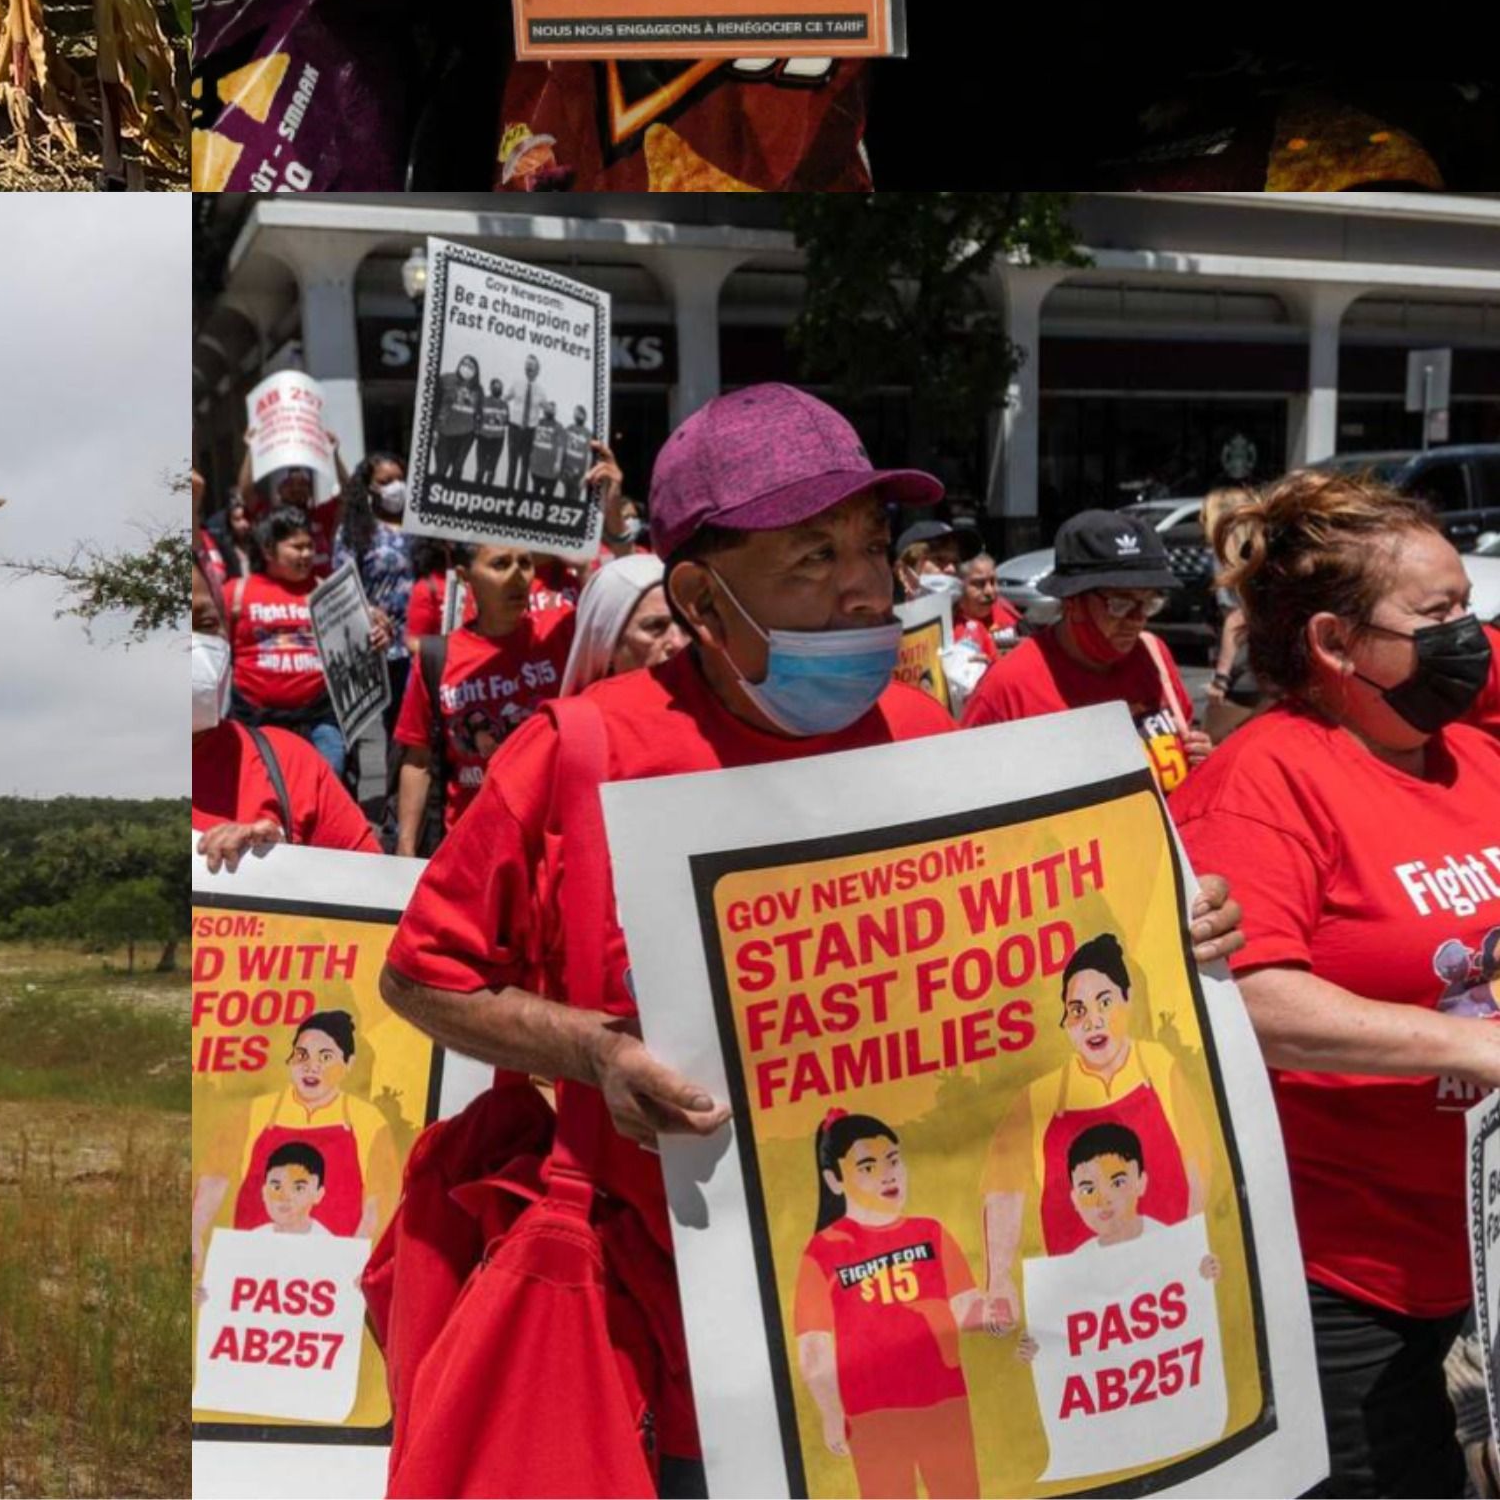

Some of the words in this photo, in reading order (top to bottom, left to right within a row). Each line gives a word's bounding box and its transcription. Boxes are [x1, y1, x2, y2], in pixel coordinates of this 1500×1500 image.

[532, 25, 572, 37] NOUS
[575, 24, 614, 37] NOUS
[616, 23, 701, 35] ENGAGEONS
[704, 19, 714, 34] À
[717, 21, 803, 34] RENÉGOCIER
[805, 21, 823, 33] CE
[826, 20, 865, 32] TARIF
[277, 62, 320, 142] SMAAK
[485, 276, 508, 295] Gov
[449, 306, 483, 331] fast
[488, 316, 526, 341] food
[530, 327, 591, 361] workers
[454, 285, 475, 307] Be
[478, 294, 488, 309] a
[492, 296, 569, 334] champion
[573, 321, 590, 338] of
[428, 484, 515, 516] Support
[517, 501, 545, 519] AB
[547, 504, 584, 527] 257
[249, 603, 287, 623] Fight
[521, 660, 556, 688] $15
[726, 888, 802, 934] GOV
[812, 840, 985, 915] NEWSOM:
[1394, 854, 1500, 917] Fight
[192, 916, 264, 937] SOM:
[734, 897, 946, 994] STAND
[958, 839, 1105, 936] WITH
[238, 945, 358, 982] WITH
[744, 969, 898, 1053] FAST
[916, 919, 1077, 1015] FOOD
[192, 989, 316, 1028] FOOD
[192, 1035, 270, 1073] IES
[755, 1000, 1038, 1111] FAMILIES
[839, 1256, 888, 1286] FIGHT
[892, 1245, 927, 1264] FOR
[861, 1261, 919, 1305] $15
[230, 1277, 337, 1317] PASS
[1065, 1280, 1188, 1358] PASS
[209, 1325, 345, 1371] AB257
[1058, 1338, 1206, 1420] AB257
